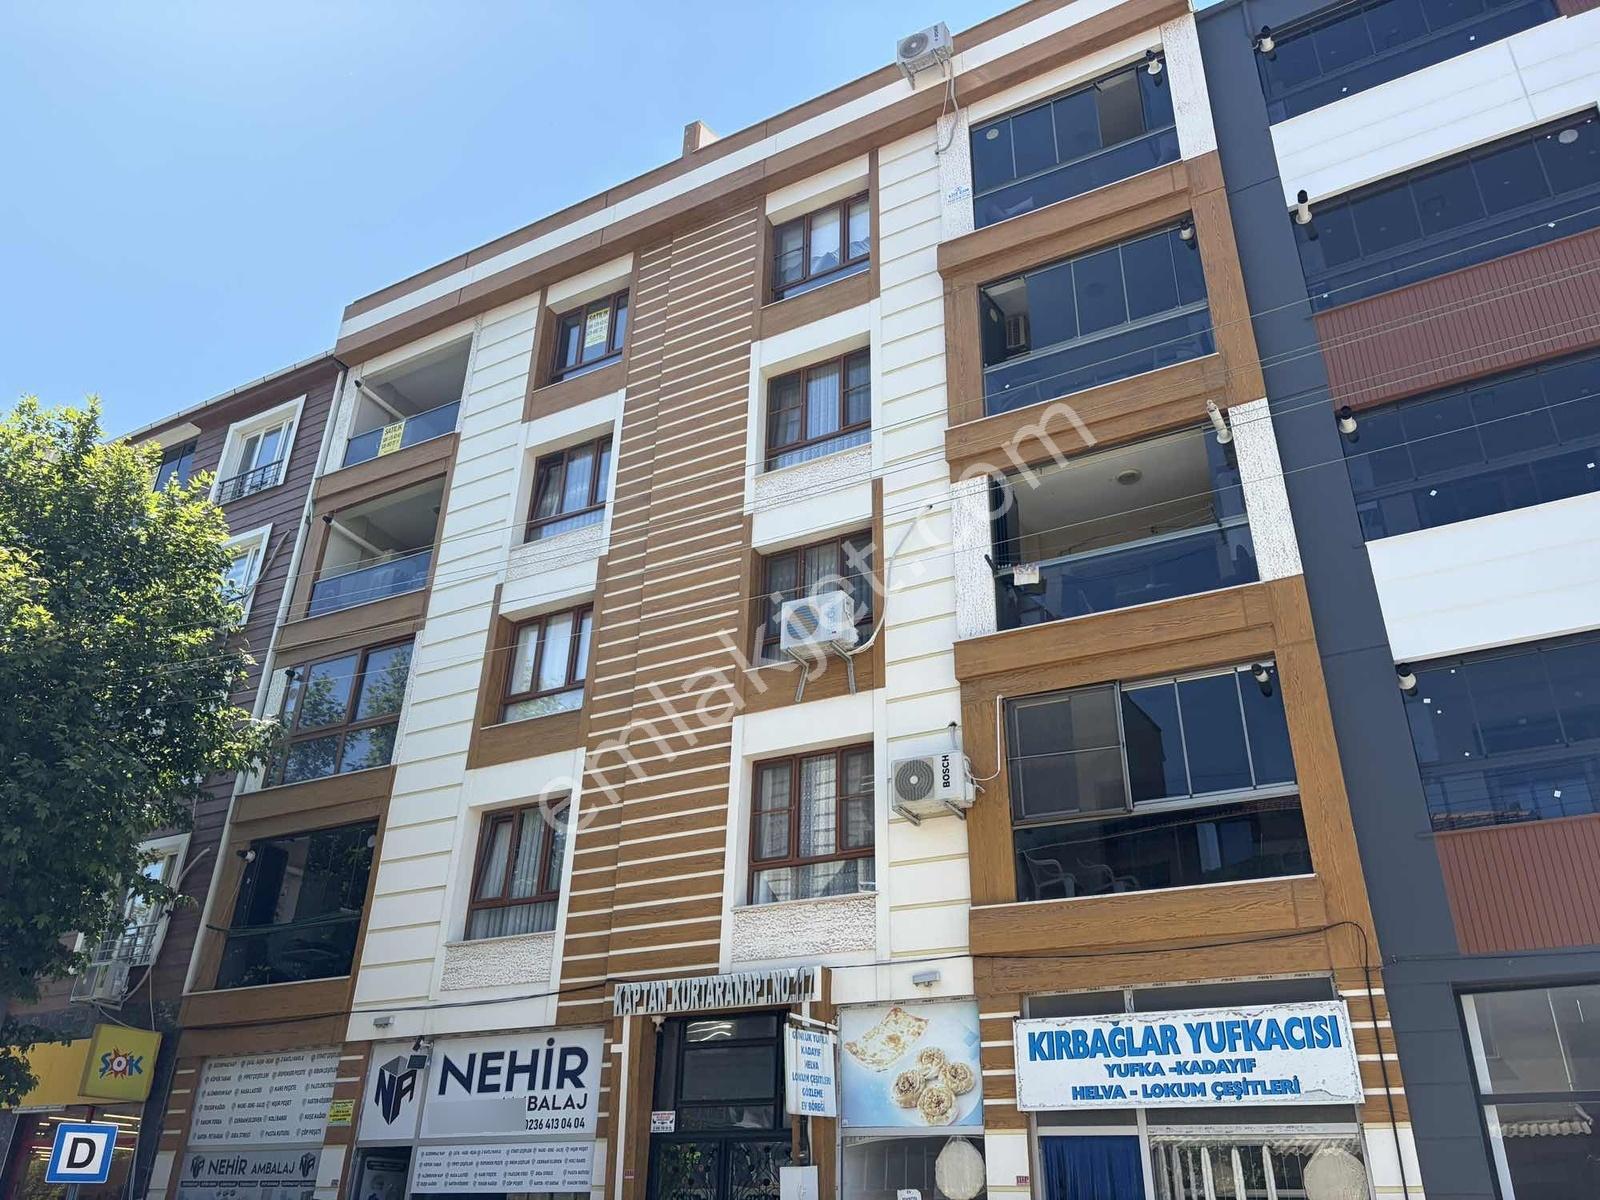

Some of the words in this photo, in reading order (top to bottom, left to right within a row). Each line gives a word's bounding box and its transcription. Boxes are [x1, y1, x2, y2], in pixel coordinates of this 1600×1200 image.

[941, 754, 951, 788] BOSCH
[614, 981, 668, 1015] KAPTAN
[1028, 1019, 1181, 1061] KIRBAĞLAR
[1184, 1015, 1342, 1054] YUFKACISI
[438, 1037, 588, 1095] NEHİR
[1104, 1063, 1165, 1078] YUFKA
[527, 1092, 588, 1112] BALAJ
[1071, 1085, 1126, 1101] HELVA
[1141, 1082, 1206, 1099] LOKUM
[1208, 1075, 1301, 1101] ÇEŞİTLERİ
[545, 1117, 559, 1130] 413
[561, 1117, 573, 1130] 04
[574, 1116, 585, 1129] 04
[66, 1137, 96, 1169] D
[207, 1154, 248, 1175] NEHİR
[251, 1161, 296, 1175] AMBALAJ
